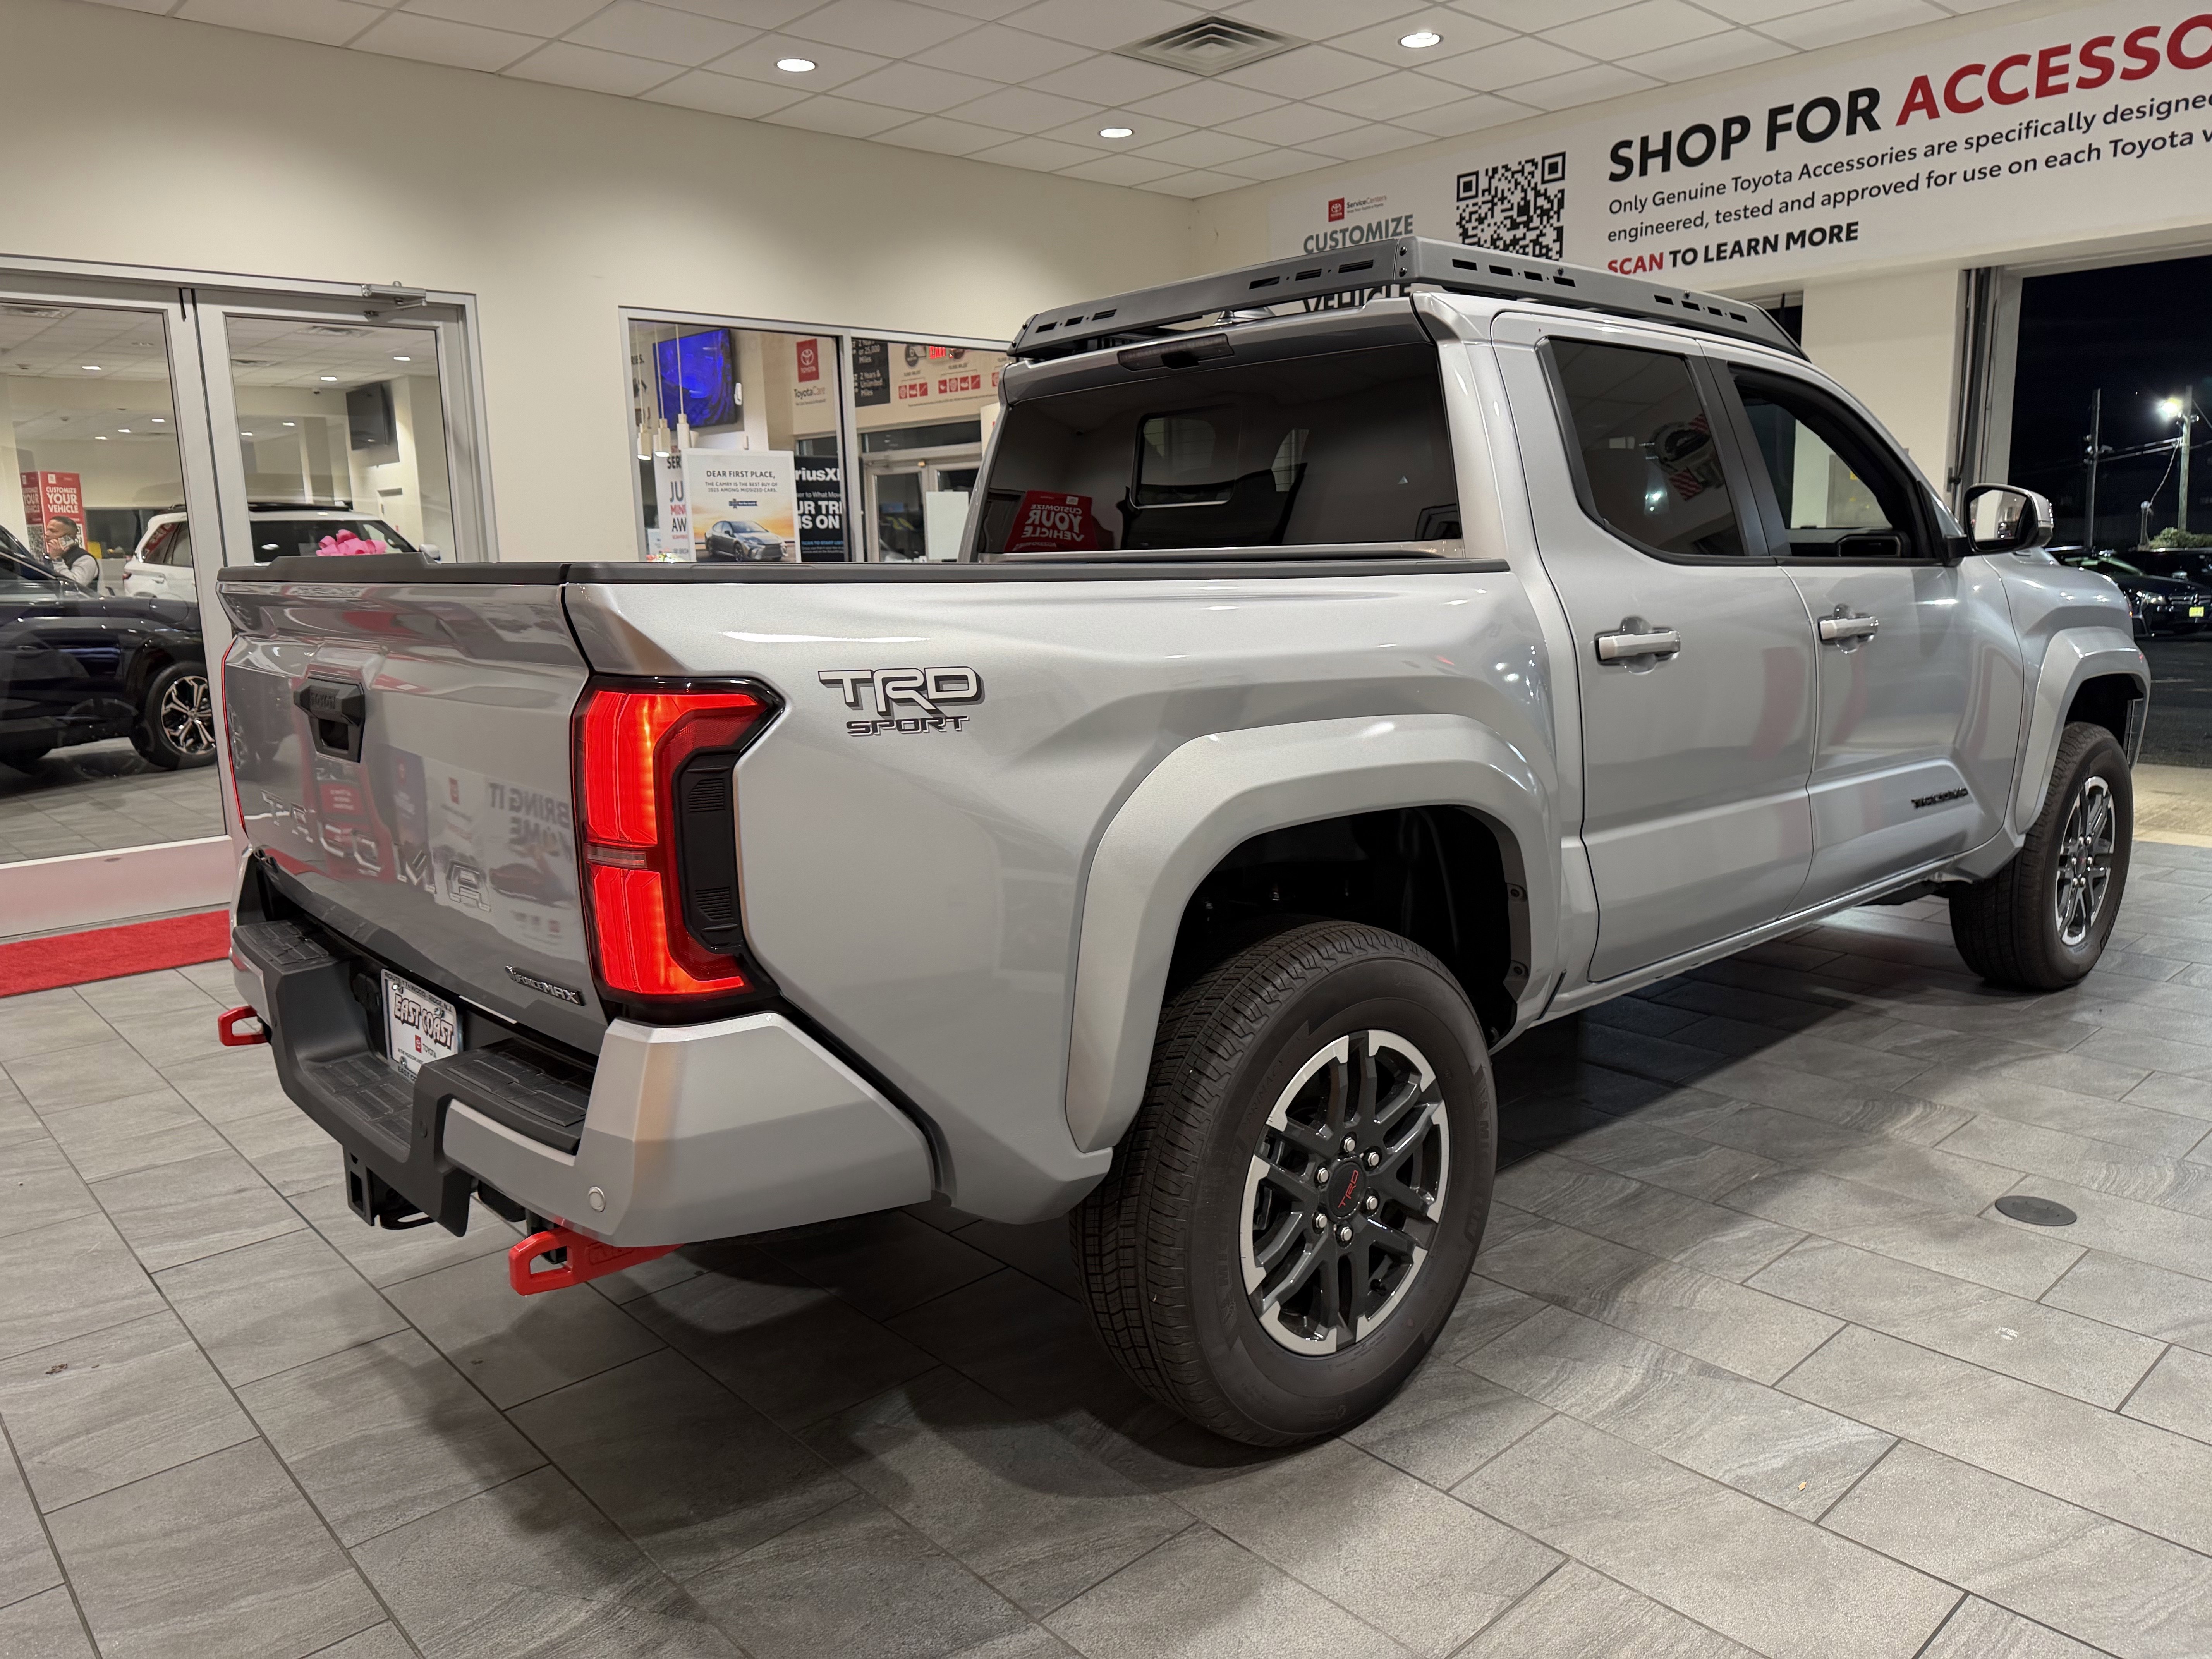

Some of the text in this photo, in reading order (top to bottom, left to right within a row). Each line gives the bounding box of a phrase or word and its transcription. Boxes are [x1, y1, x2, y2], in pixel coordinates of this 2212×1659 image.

[1608, 14, 2212, 182] SHOP FOR ACCESSO
[1609, 94, 2212, 215] Only Genuine Toyota Accessories are specifically designe
[1608, 211, 1709, 243] engineered,
[1716, 200, 1773, 225] tested
[1779, 192, 1815, 214] and
[1821, 173, 1919, 207] approved
[1926, 169, 1957, 189] for
[1963, 165, 2002, 182] use
[2008, 158, 2037, 175] on
[2045, 143, 2101, 168] each
[2110, 129, 2193, 159] Toyota
[1304, 214, 1413, 254] CUSTOMIZE
[1608, 221, 1859, 275] SCAN TO LEARN MORE
[794, 386, 825, 399] ToyotaCare
[750, 471, 775, 479] PLACE,
[795, 467, 840, 481] riusX
[46, 493, 78, 505] YOUR
[48, 504, 79, 514] VEHICLE
[816, 515, 840, 529] ON
[817, 666, 983, 718] TRD
[846, 716, 970, 736] SPORT
[261, 789, 491, 912] TACOMA
[385, 972, 401, 984] ROUTE
[394, 993, 454, 1051] EAST COAST
[422, 1043, 436, 1059] TOYOTA
[1338, 1169, 1359, 1208] TRD
